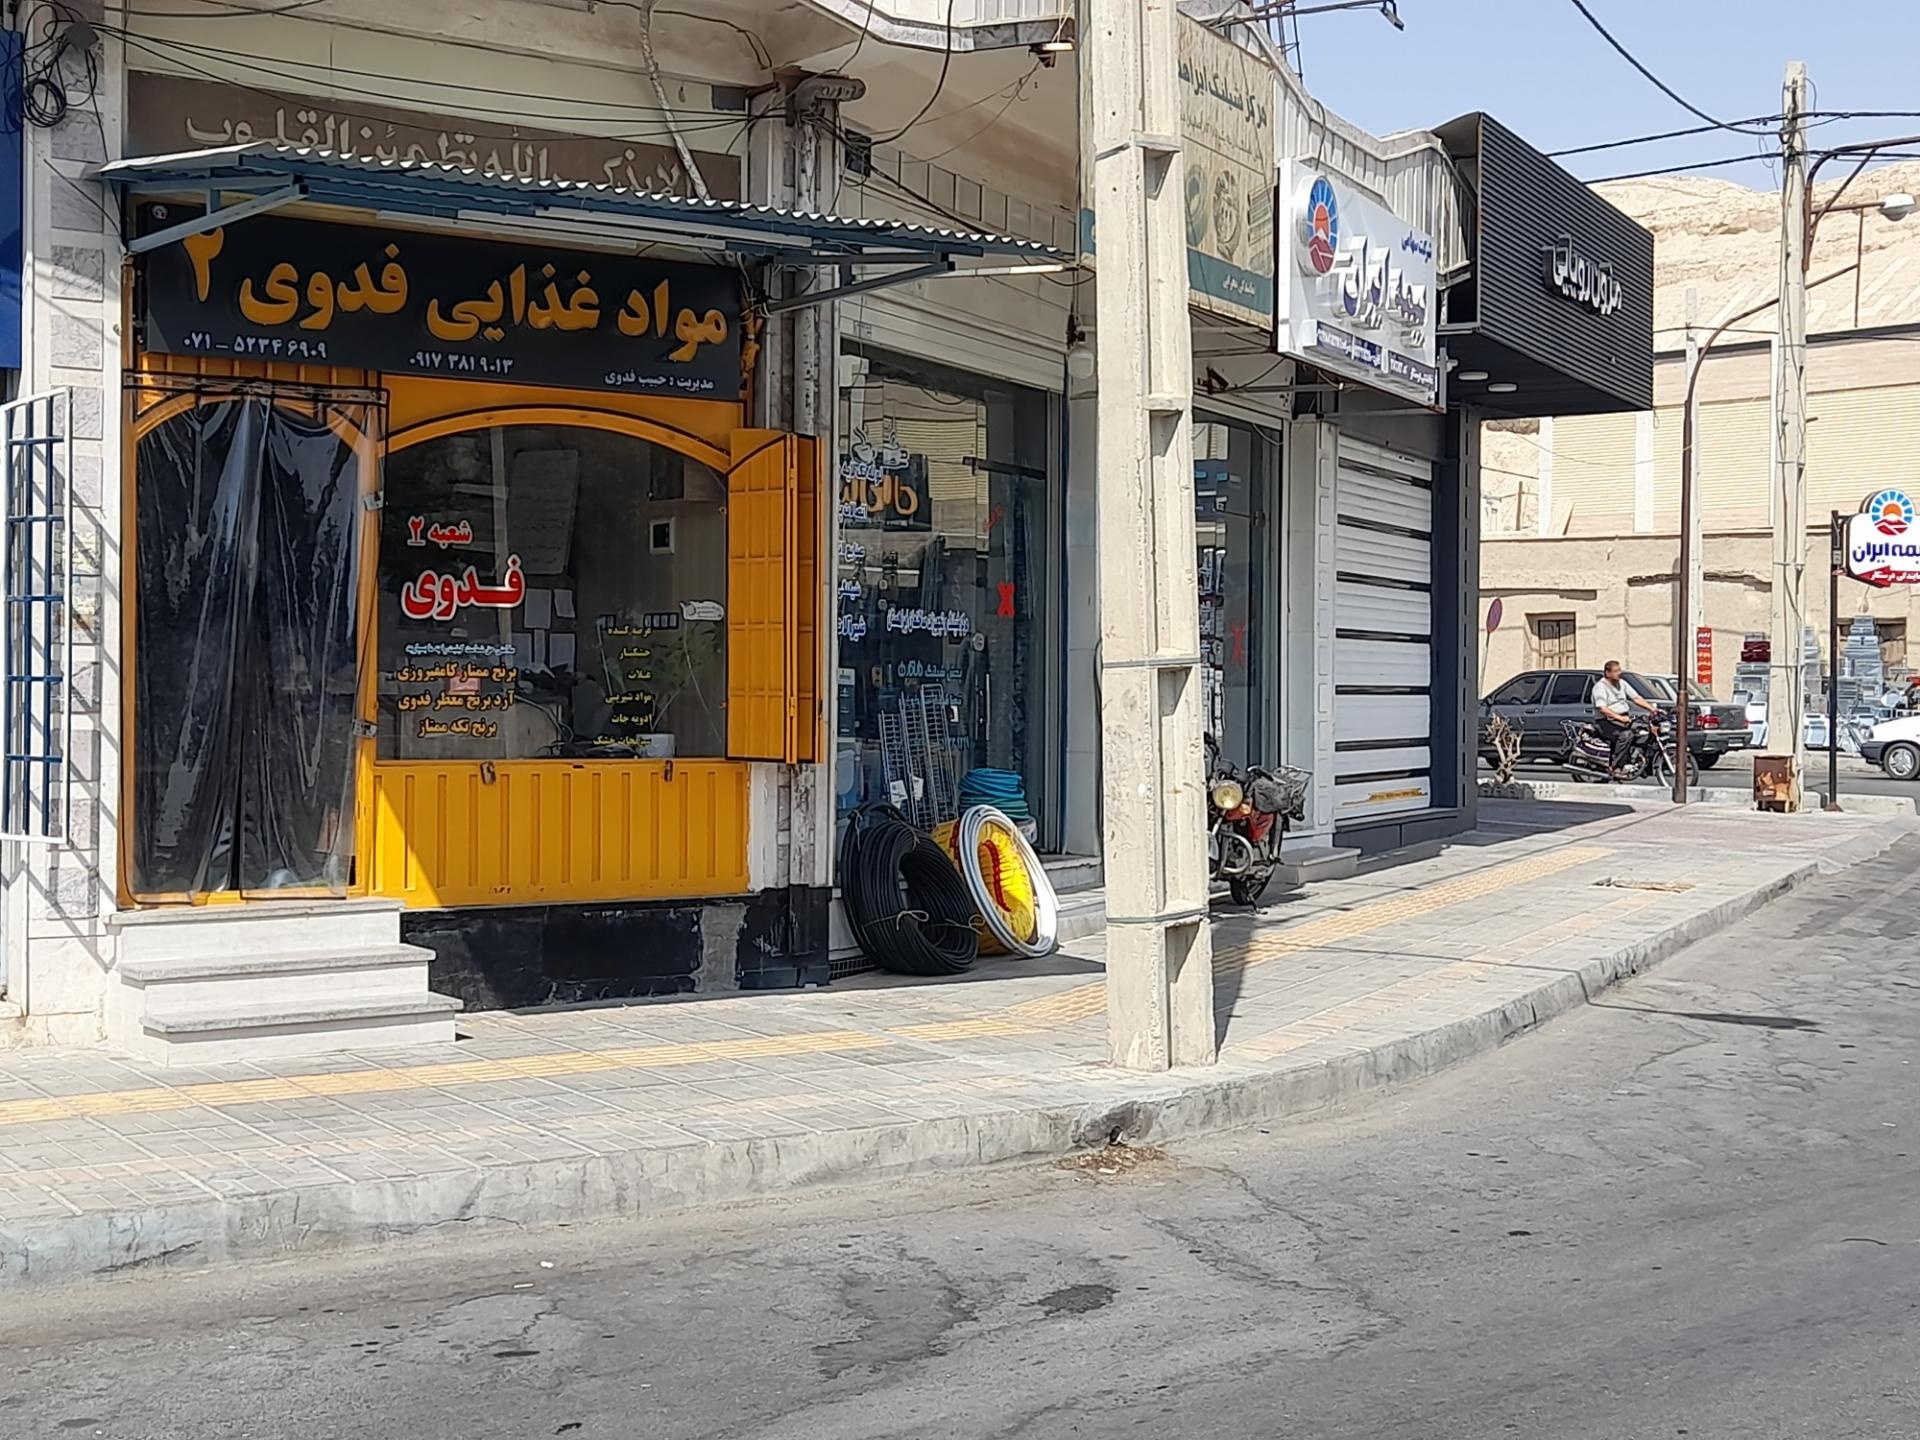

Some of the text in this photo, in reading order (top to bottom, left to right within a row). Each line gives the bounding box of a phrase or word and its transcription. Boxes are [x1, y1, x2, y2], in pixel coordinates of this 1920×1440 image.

[182, 227, 728, 362] مواد غذایی فدوی ۲
[184, 332, 211, 349] ۰۷۱
[409, 351, 513, 374] ۰۹۱۷ ۳۸۱ ۹۰۱۳
[605, 368, 636, 385] فدوی
[638, 374, 667, 387] حبیب
[676, 376, 714, 391] مدیریت
[407, 515, 474, 549] شعبه ۲
[1852, 541, 1890, 564] ایران
[401, 553, 526, 621] فدوی
[459, 662, 490, 682] ممتاز
[492, 661, 518, 682] برنج
[397, 689, 516, 710] آرد برنج معطر فدوی
[418, 717, 448, 738] ممتاز
[472, 717, 497, 737] برنج
